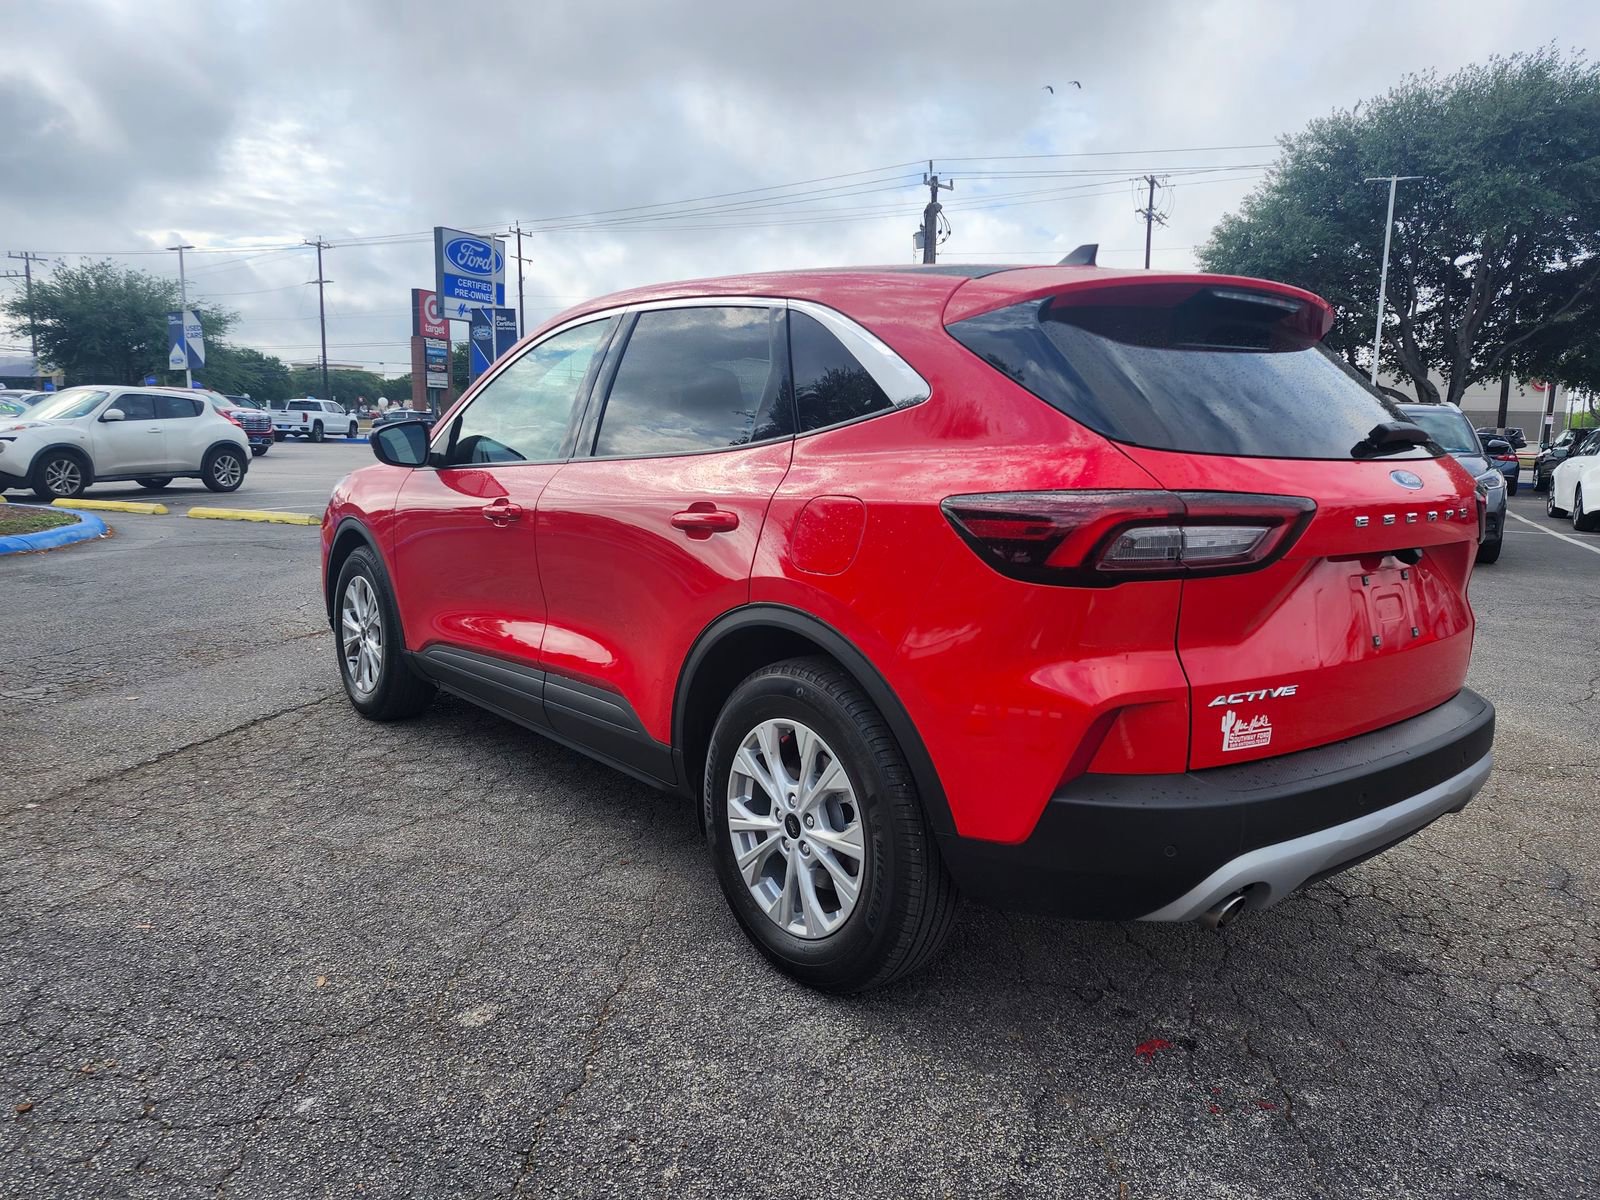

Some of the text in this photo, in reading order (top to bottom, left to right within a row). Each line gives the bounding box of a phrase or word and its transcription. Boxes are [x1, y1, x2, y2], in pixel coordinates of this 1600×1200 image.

[457, 242, 493, 271] Ford
[457, 278, 493, 292] CERTIFIED
[425, 323, 446, 336] target
[1355, 507, 1468, 528] ESCAPE
[1208, 685, 1299, 707] ACTIVE
[1257, 731, 1271, 740] FORD
